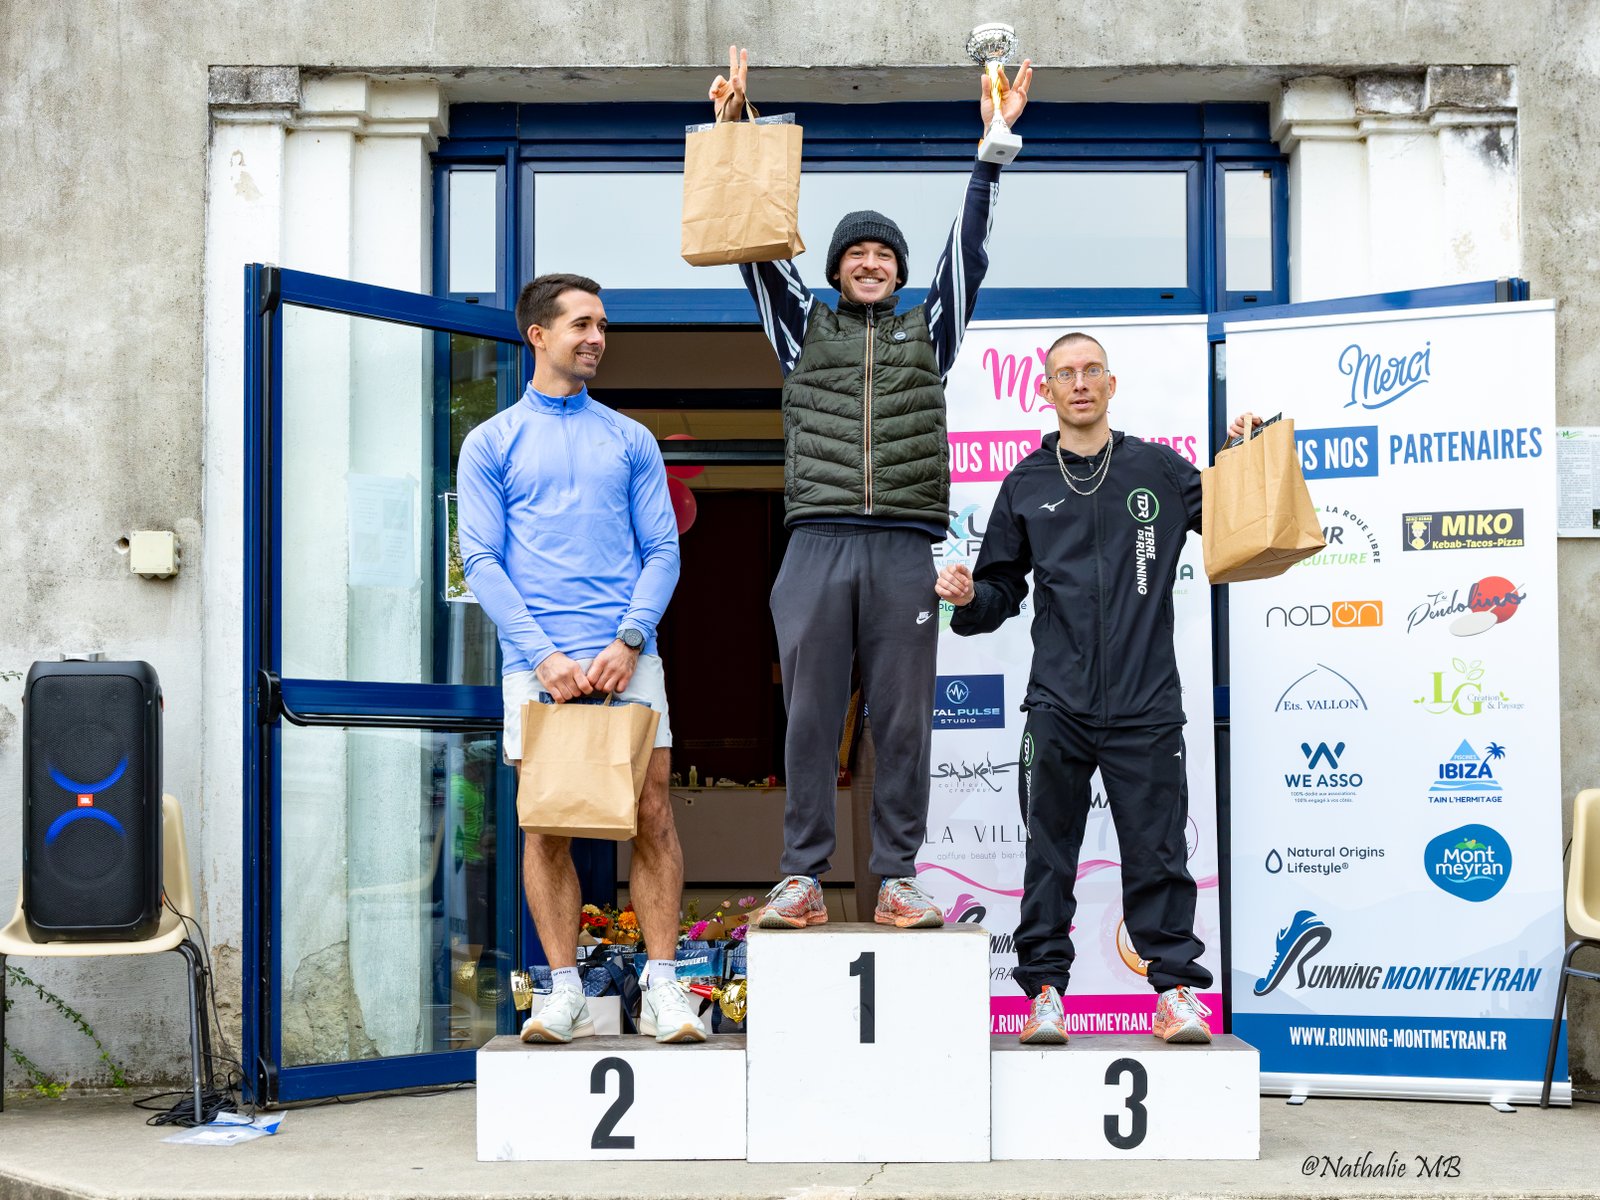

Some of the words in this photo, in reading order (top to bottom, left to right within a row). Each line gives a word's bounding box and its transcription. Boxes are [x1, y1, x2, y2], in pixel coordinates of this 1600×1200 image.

[1338, 341, 1431, 409] Merci
[1324, 436, 1369, 470] NOS
[1390, 426, 1543, 465] PARTENAIRES
[1326, 505, 1339, 514] LA
[1342, 510, 1369, 532] ROUE
[1367, 533, 1381, 564] LIBRE
[1441, 512, 1514, 537] MIKO
[1144, 524, 1156, 560] TERRE
[1432, 537, 1523, 549] Kebab-Tacos-Pizza
[1135, 540, 1148, 596] RUNNING
[1294, 552, 1368, 567] CULTURE
[1283, 700, 1303, 711] Ets.
[1306, 699, 1360, 711] VALLON
[1424, 671, 1482, 716] LG
[957, 707, 1001, 716] PULSE
[1284, 774, 1312, 787] WE
[1316, 773, 1363, 787] ASSO
[1439, 763, 1493, 779] IBIZA
[1428, 796, 1448, 804] TAIN
[924, 826, 954, 844] LA
[1287, 847, 1335, 858] Natural
[1339, 847, 1385, 861] Origins
[1443, 846, 1495, 863] Mont
[1435, 860, 1504, 879] meyran
[1382, 965, 1543, 992] MONTMEYRAN
[849, 951, 876, 1044] 1
[1289, 1026, 1507, 1051] WWW.RUNNING-MONTMEYRAN.FR
[590, 1056, 635, 1150] 2
[1103, 1057, 1148, 1150] 3
